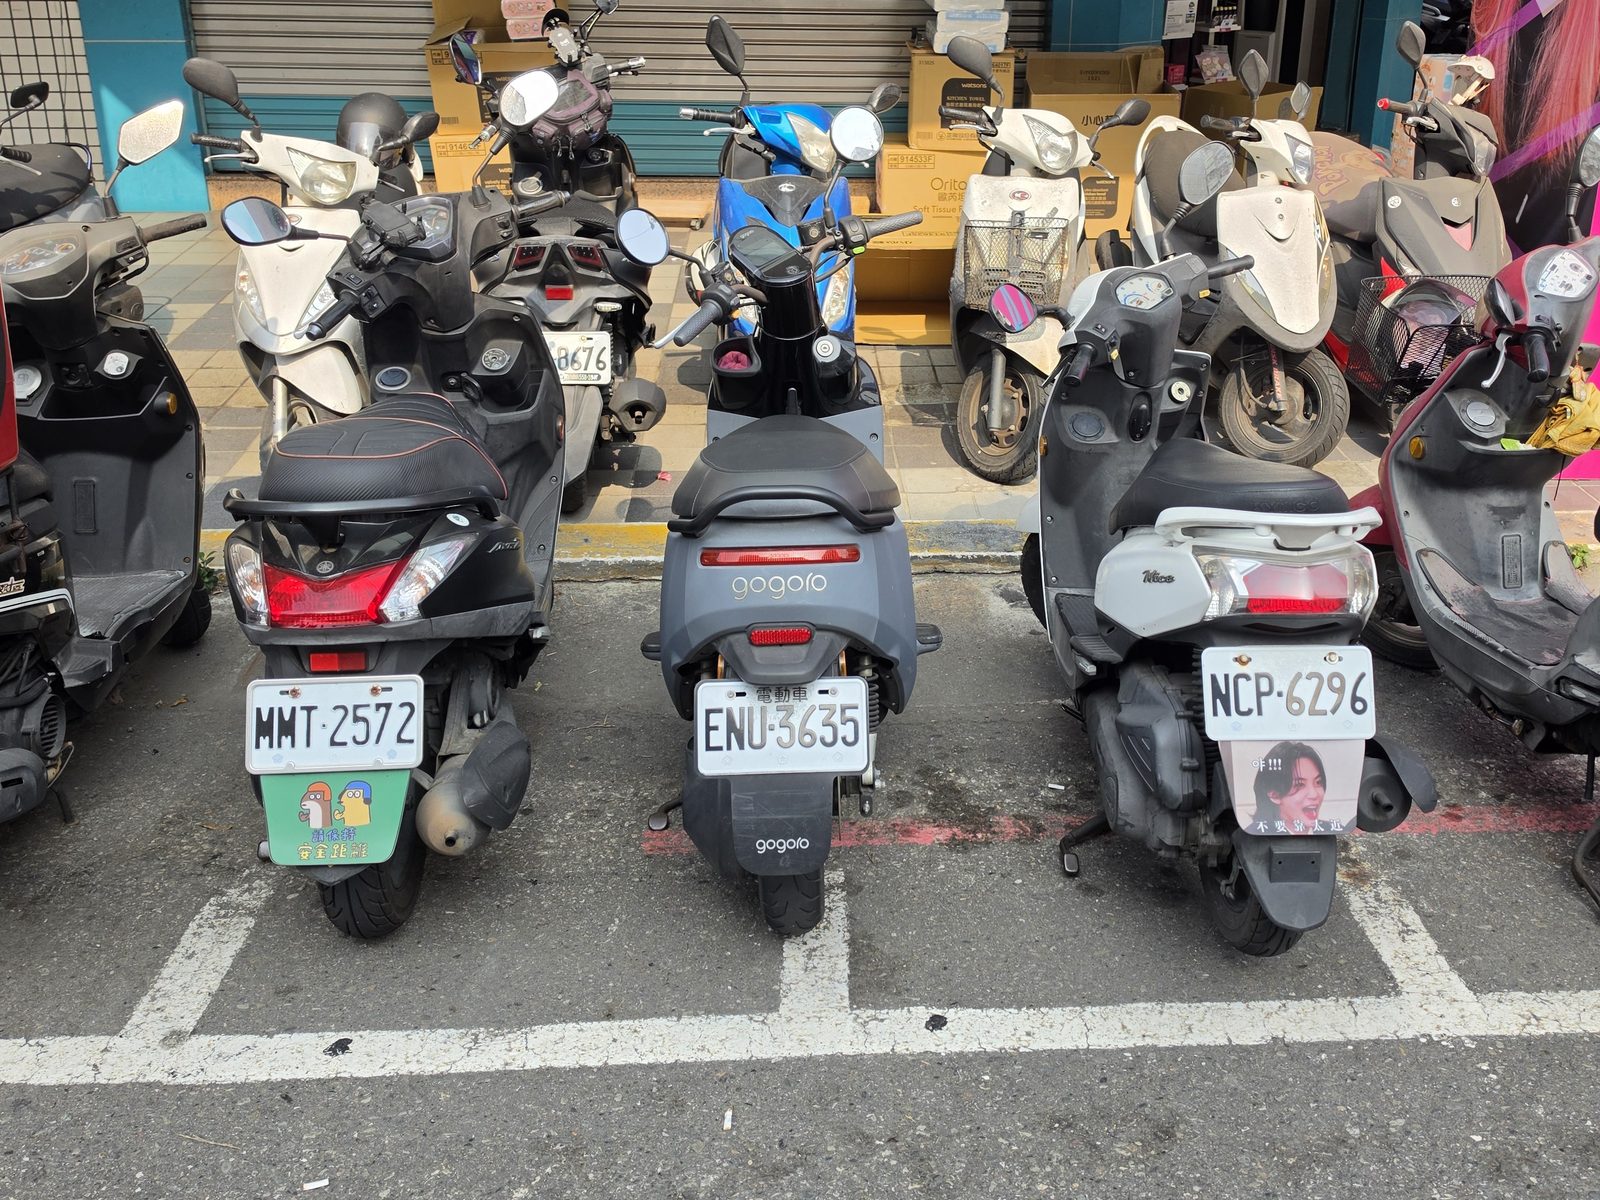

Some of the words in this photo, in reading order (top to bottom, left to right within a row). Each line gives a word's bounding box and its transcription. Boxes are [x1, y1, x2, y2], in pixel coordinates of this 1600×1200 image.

[732, 572, 827, 600] gogoro
[756, 686, 808, 703] 電動車
[312, 827, 356, 843] 請保持
[297, 842, 369, 861] 安全距離
[755, 837, 810, 854] gogoro
